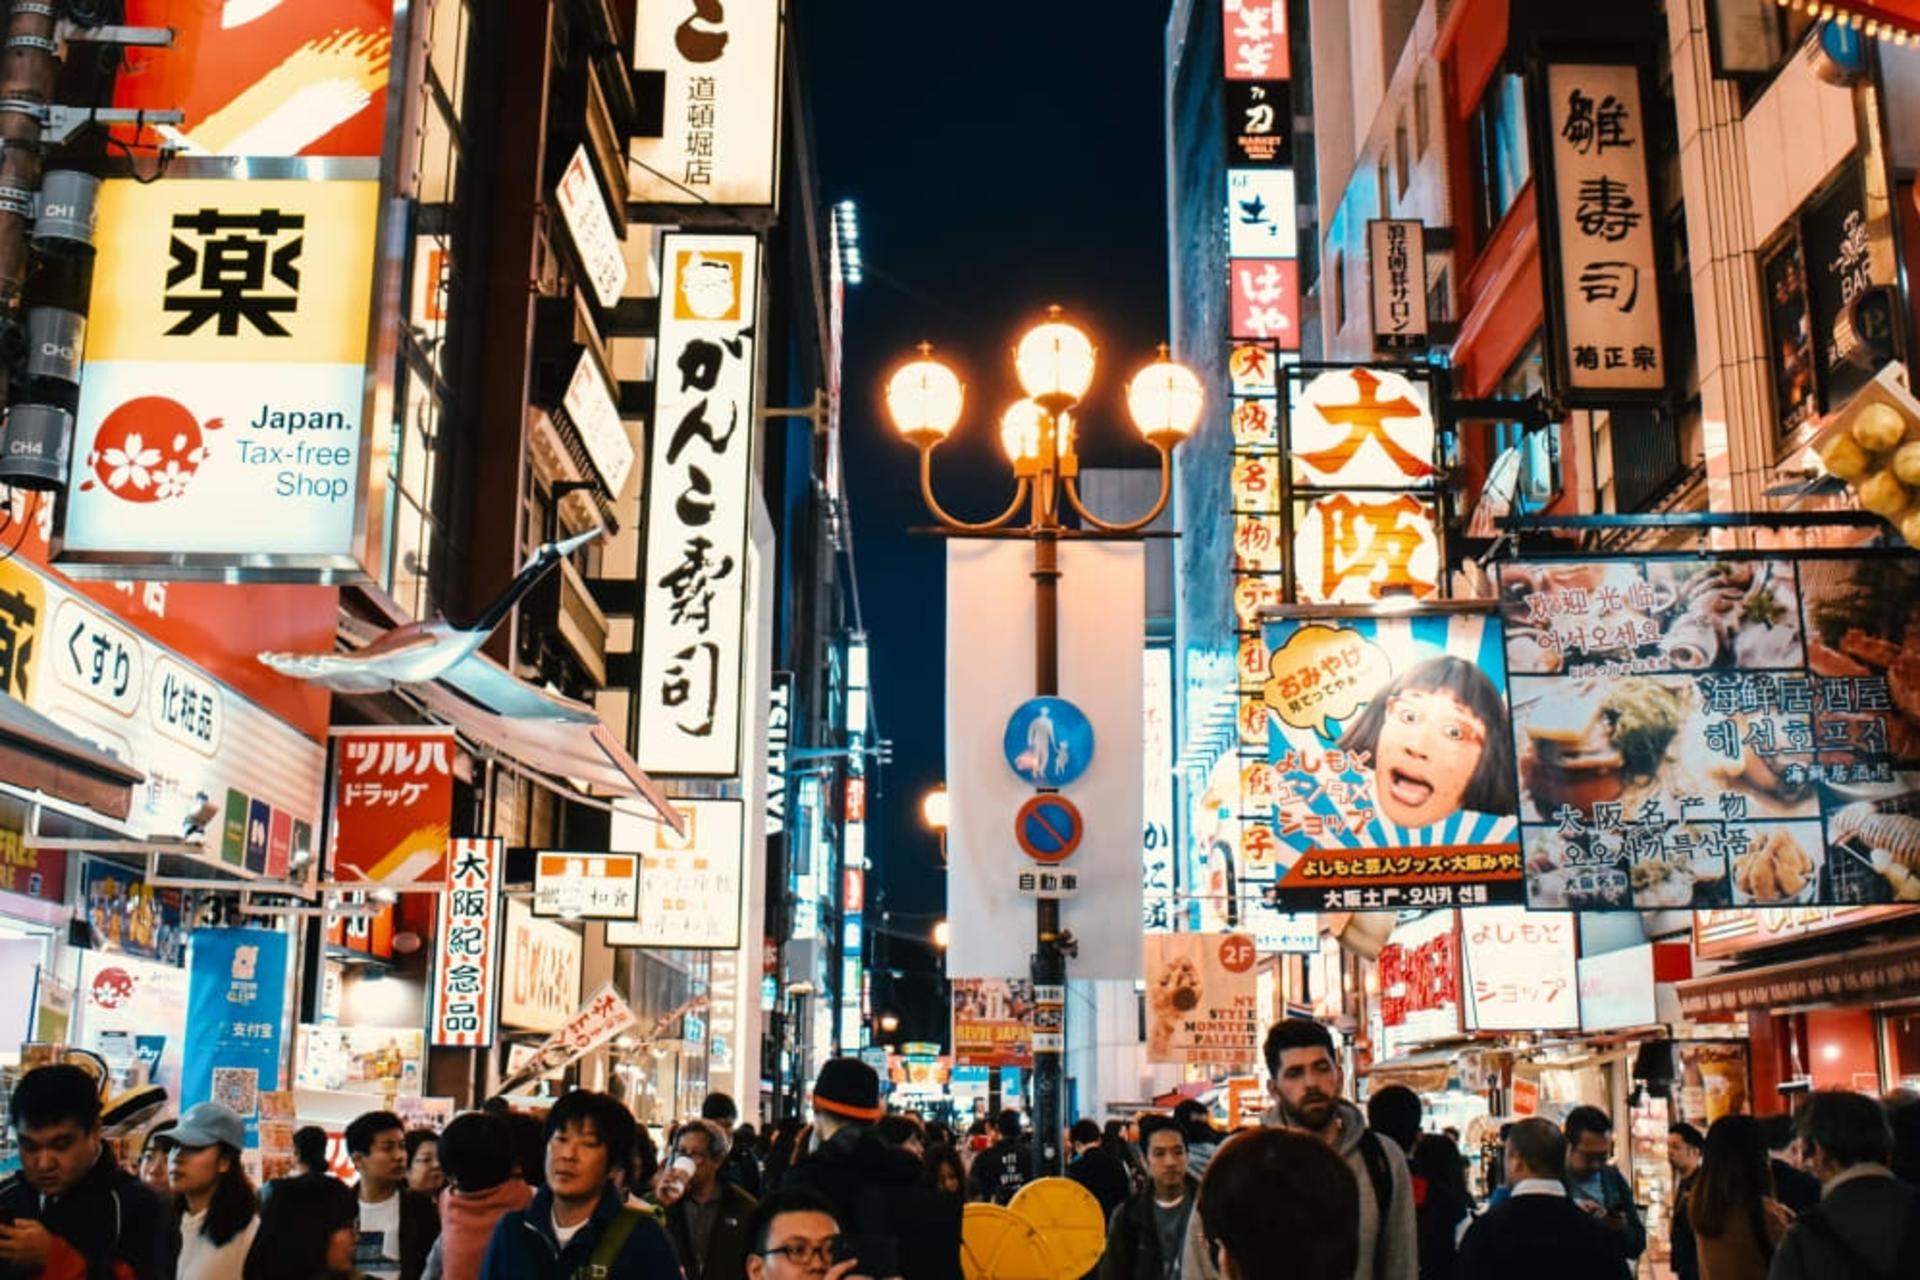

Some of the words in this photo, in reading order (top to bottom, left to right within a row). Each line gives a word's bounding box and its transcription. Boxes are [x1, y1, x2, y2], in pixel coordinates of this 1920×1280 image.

[683, 76, 717, 187] 道頓堀店
[45, 204, 76, 219] CH1
[162, 208, 306, 337] 薬
[1573, 345, 1657, 371] 菊正宗
[251, 405, 353, 432] Japan.
[10, 440, 43, 456] CH4
[238, 440, 351, 465] Tax-free
[275, 473, 349, 501] Shop
[1293, 367, 1449, 601] 大阪
[1537, 619, 1664, 654] 어서오세요
[68, 621, 131, 698] くすり
[161, 671, 214, 742] 化粧品
[345, 741, 450, 777] ツルハ
[343, 780, 430, 808] ドラッグ
[1279, 807, 1374, 837] ショップ
[1552, 792, 1748, 836] 大阪名产物
[1018, 868, 1079, 891] 自動車
[443, 850, 488, 1033] 大阪紀念品
[1471, 924, 1561, 945] よしもと
[1223, 945, 1252, 964] 2F
[1476, 978, 1567, 1003] ショップ
[1184, 1021, 1256, 1033] MONSTER
[1208, 1008, 1257, 1020] STYLE
[231, 1022, 273, 1039] 支付宝
